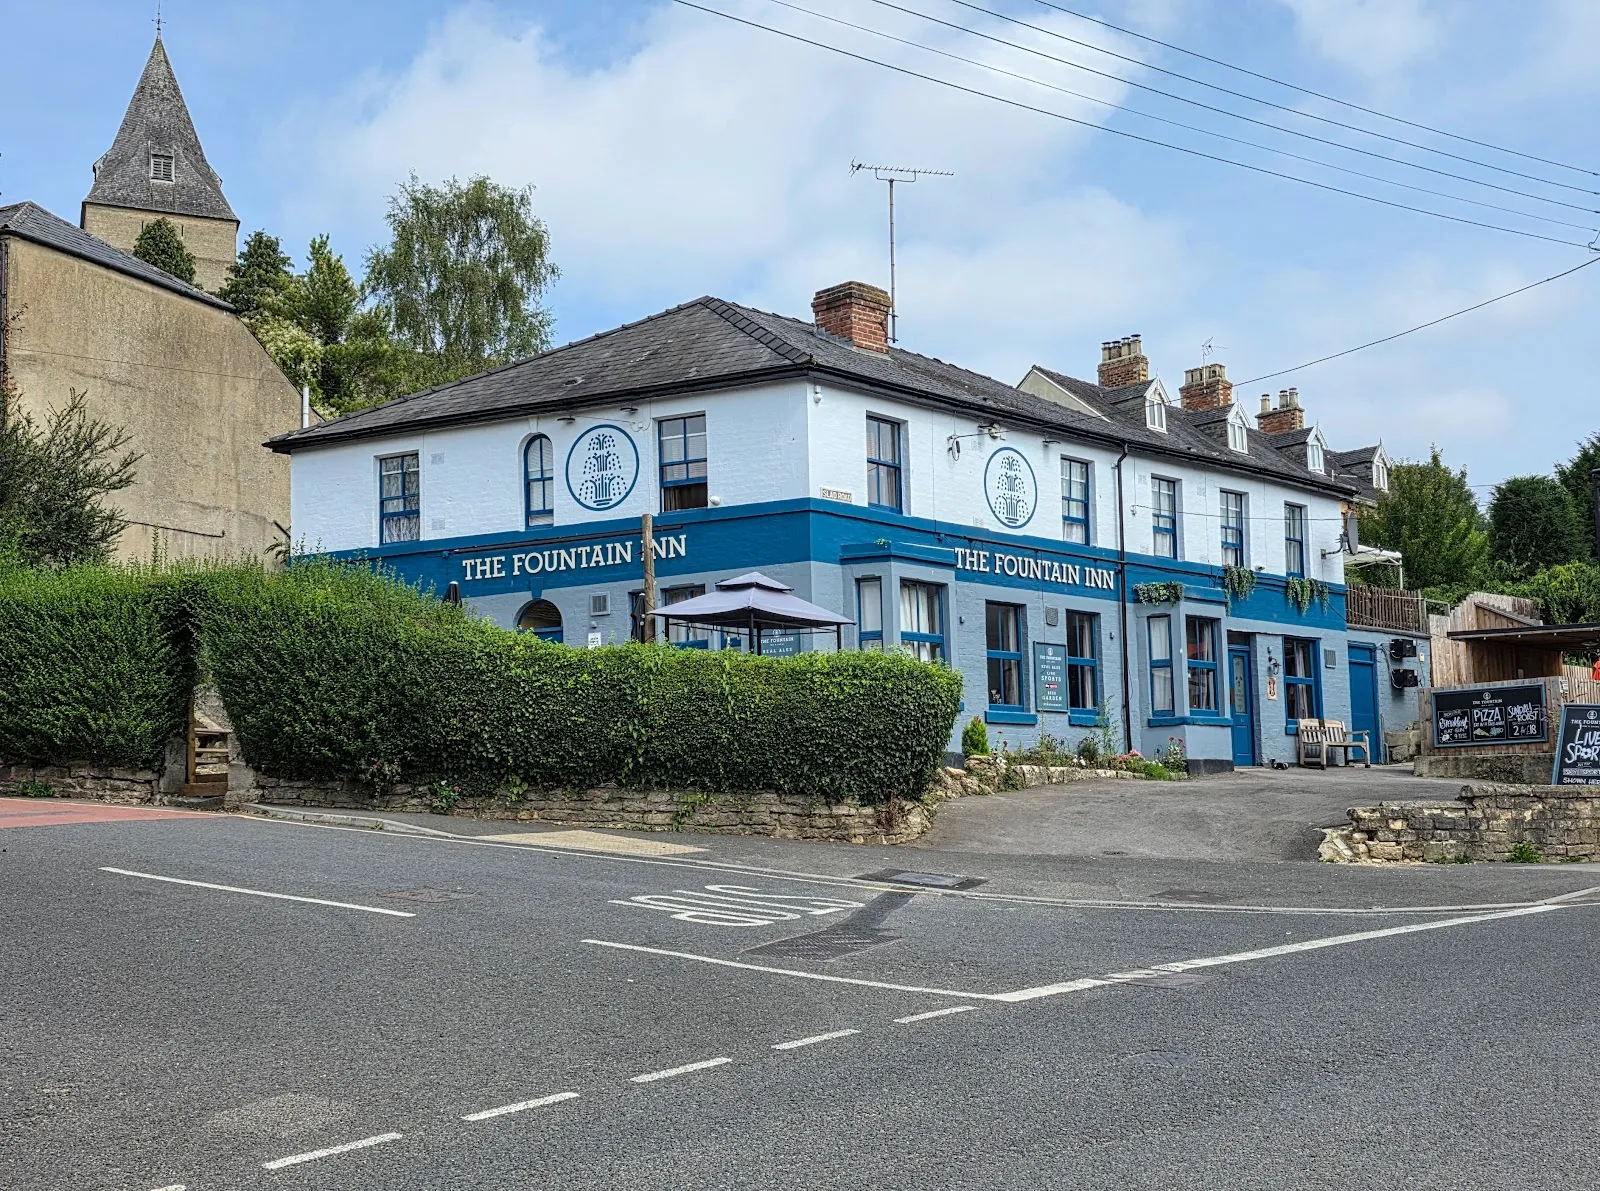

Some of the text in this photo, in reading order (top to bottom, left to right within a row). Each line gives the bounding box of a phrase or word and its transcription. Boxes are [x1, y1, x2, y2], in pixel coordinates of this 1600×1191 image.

[822, 489, 852, 502] SLAD ROAD
[463, 556, 506, 581] THE
[512, 541, 633, 576] FOUNTAIN
[954, 547, 1114, 590] THE FOUNTAIN INN
[1474, 707, 1501, 722] PIZZA
[1516, 710, 1539, 722] ROAST
[1513, 725, 1520, 735] 2
[1575, 729, 1600, 746] LIVE
